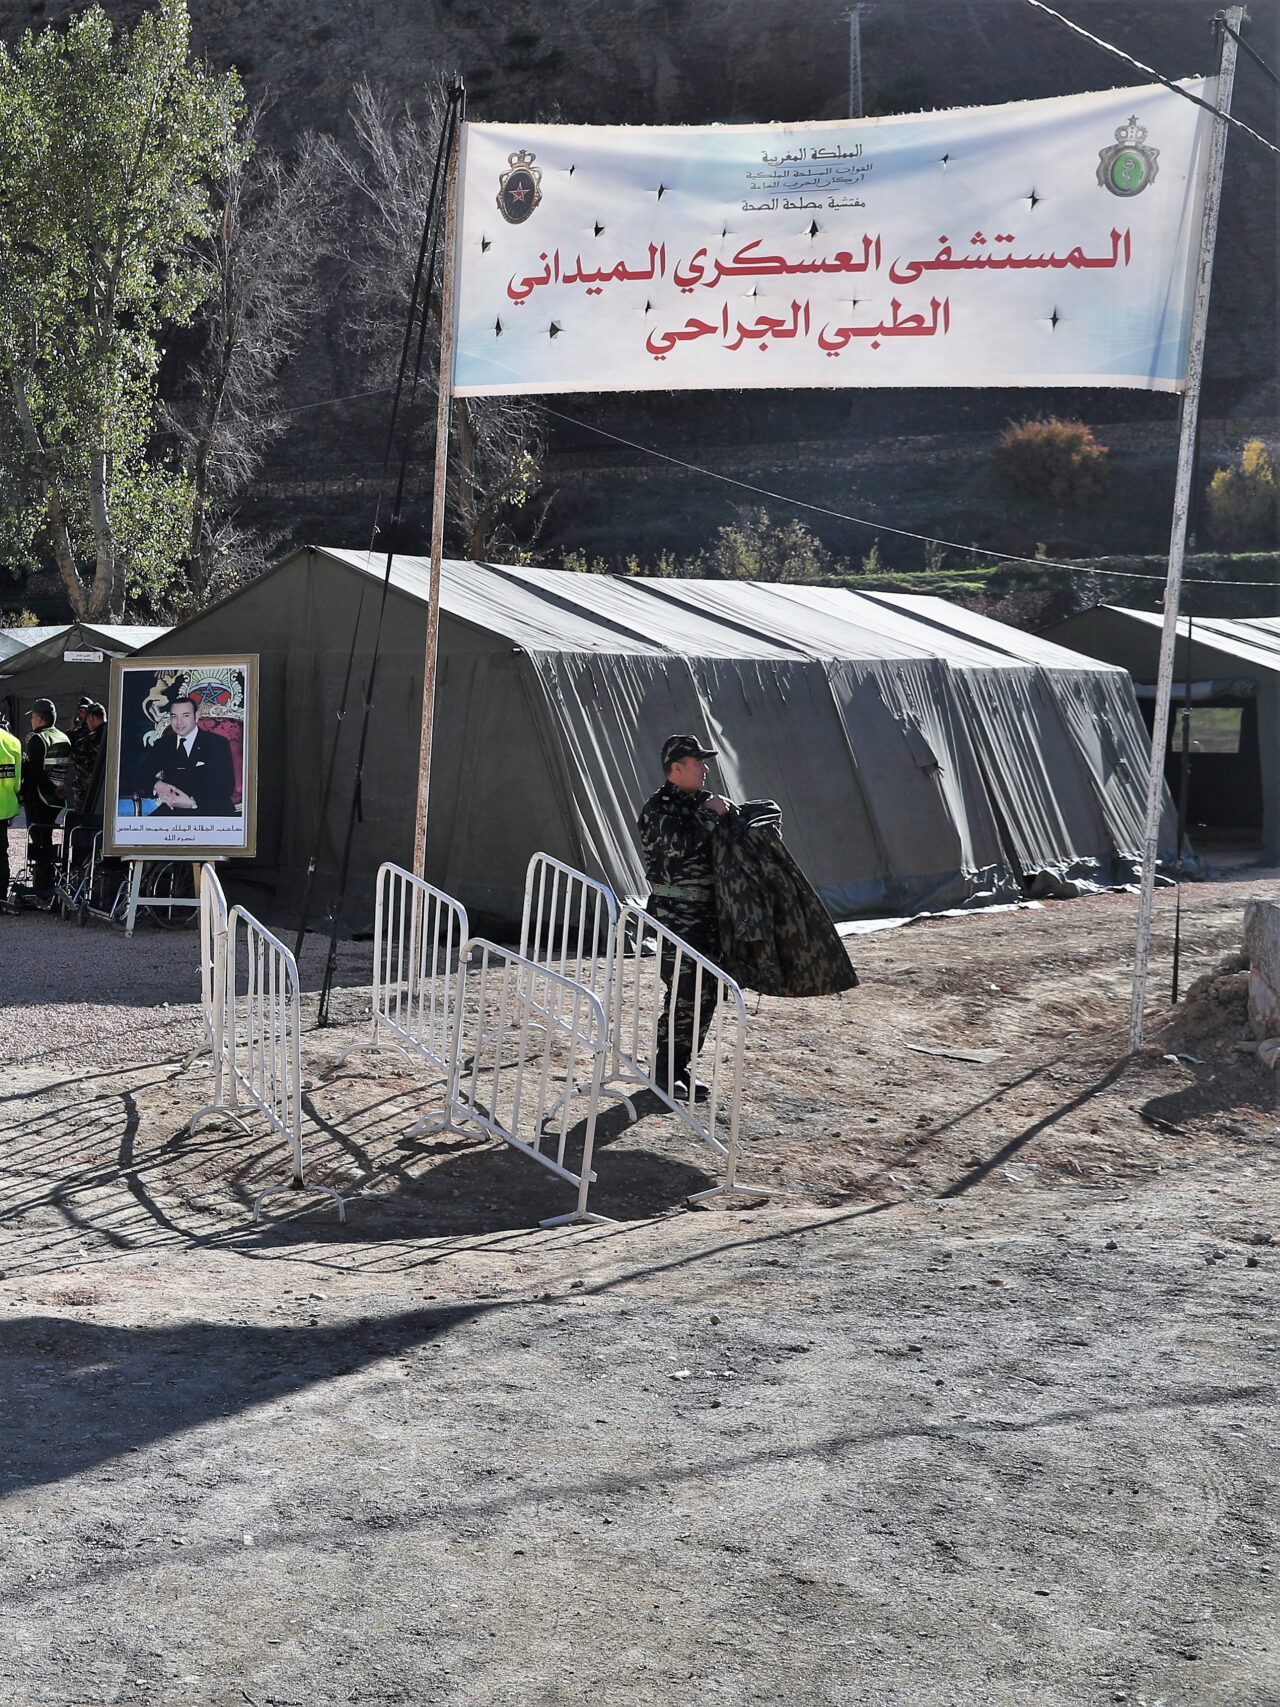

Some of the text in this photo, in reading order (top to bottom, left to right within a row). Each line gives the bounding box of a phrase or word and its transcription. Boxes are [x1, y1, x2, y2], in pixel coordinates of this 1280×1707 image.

[761, 144, 863, 167] المملكة المغربية
[746, 170, 790, 180] الملكية
[742, 196, 866, 211] مفتشية مصلحة الصحة
[506, 227, 1131, 306] المستشفى العسكري الميداني
[645, 296, 950, 361] الطبي الجراحي
